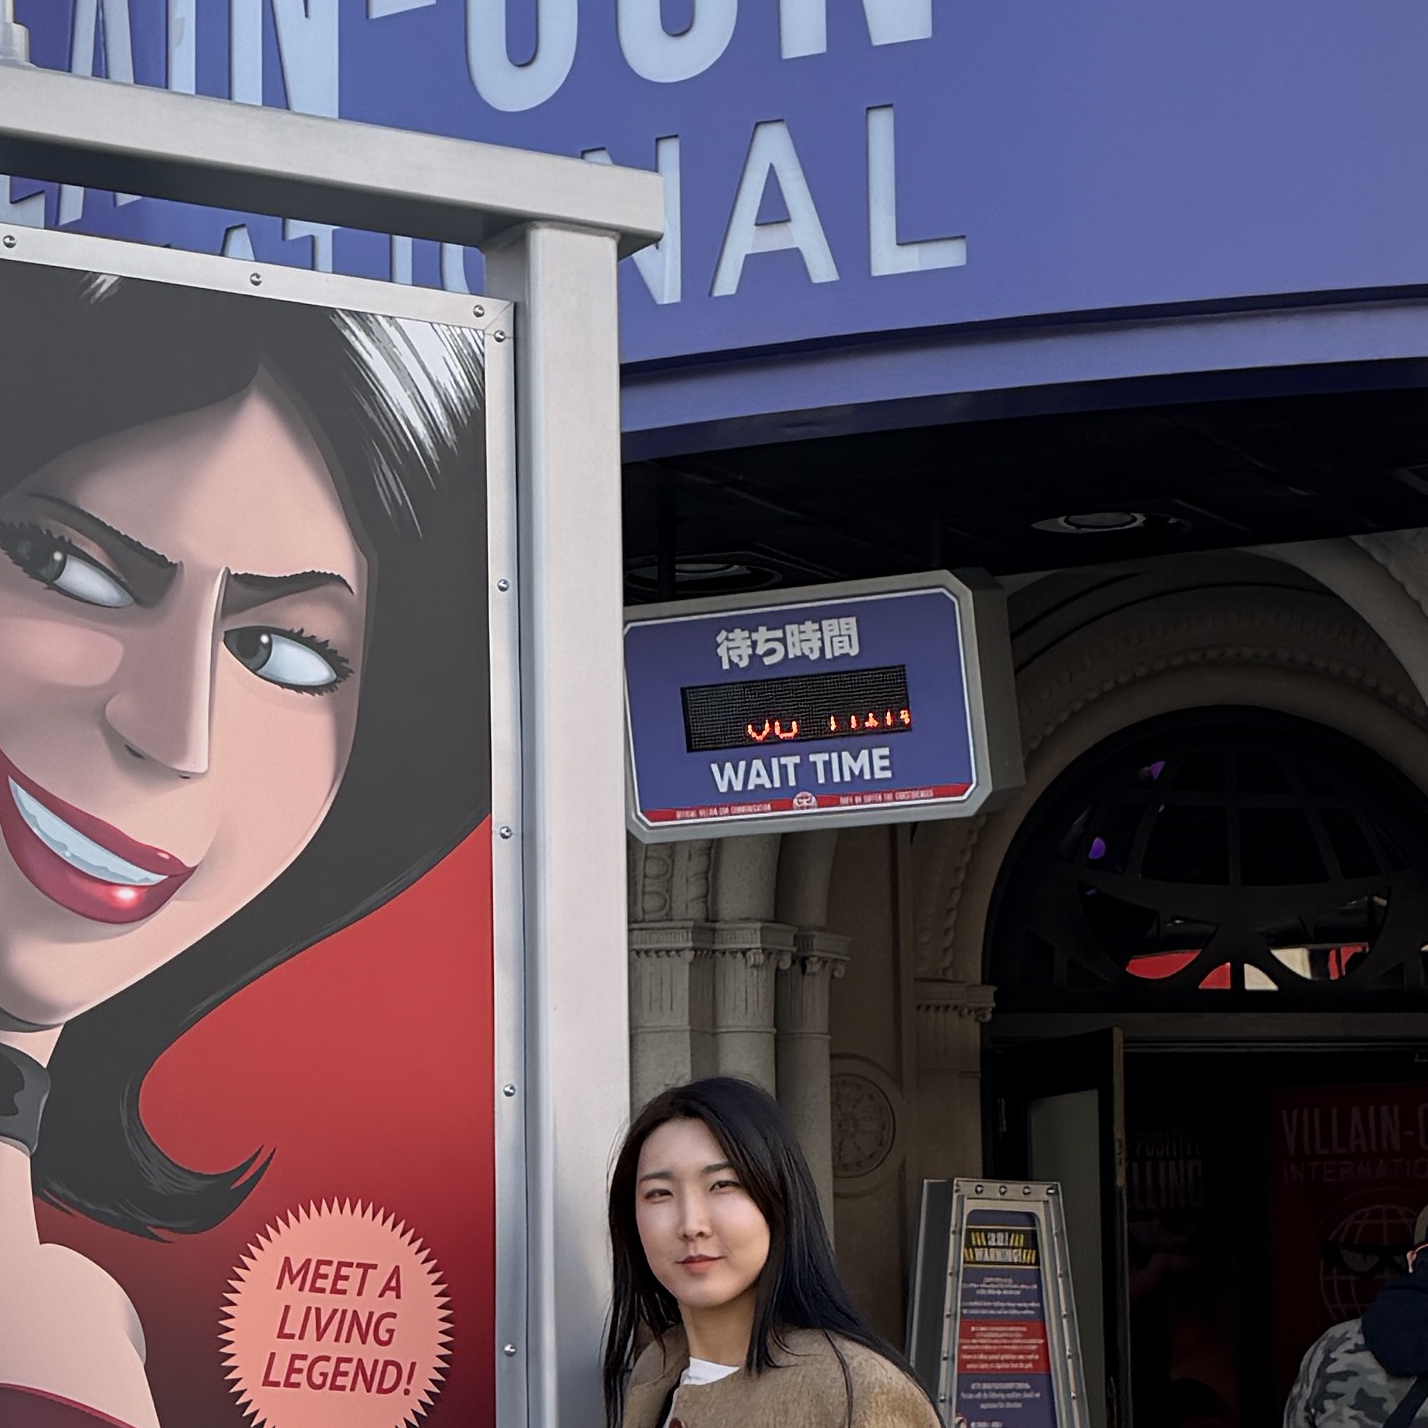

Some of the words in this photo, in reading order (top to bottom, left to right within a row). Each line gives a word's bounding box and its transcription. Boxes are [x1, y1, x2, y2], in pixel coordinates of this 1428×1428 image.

[715, 615, 860, 670] 待ち時間
[710, 755, 801, 793] WAIT
[809, 747, 892, 784] TIME
[275, 1256, 378, 1297] MEET
[378, 1264, 402, 1300] A
[276, 1304, 398, 1347] LIVING
[261, 1351, 417, 1396] LEGEND!
